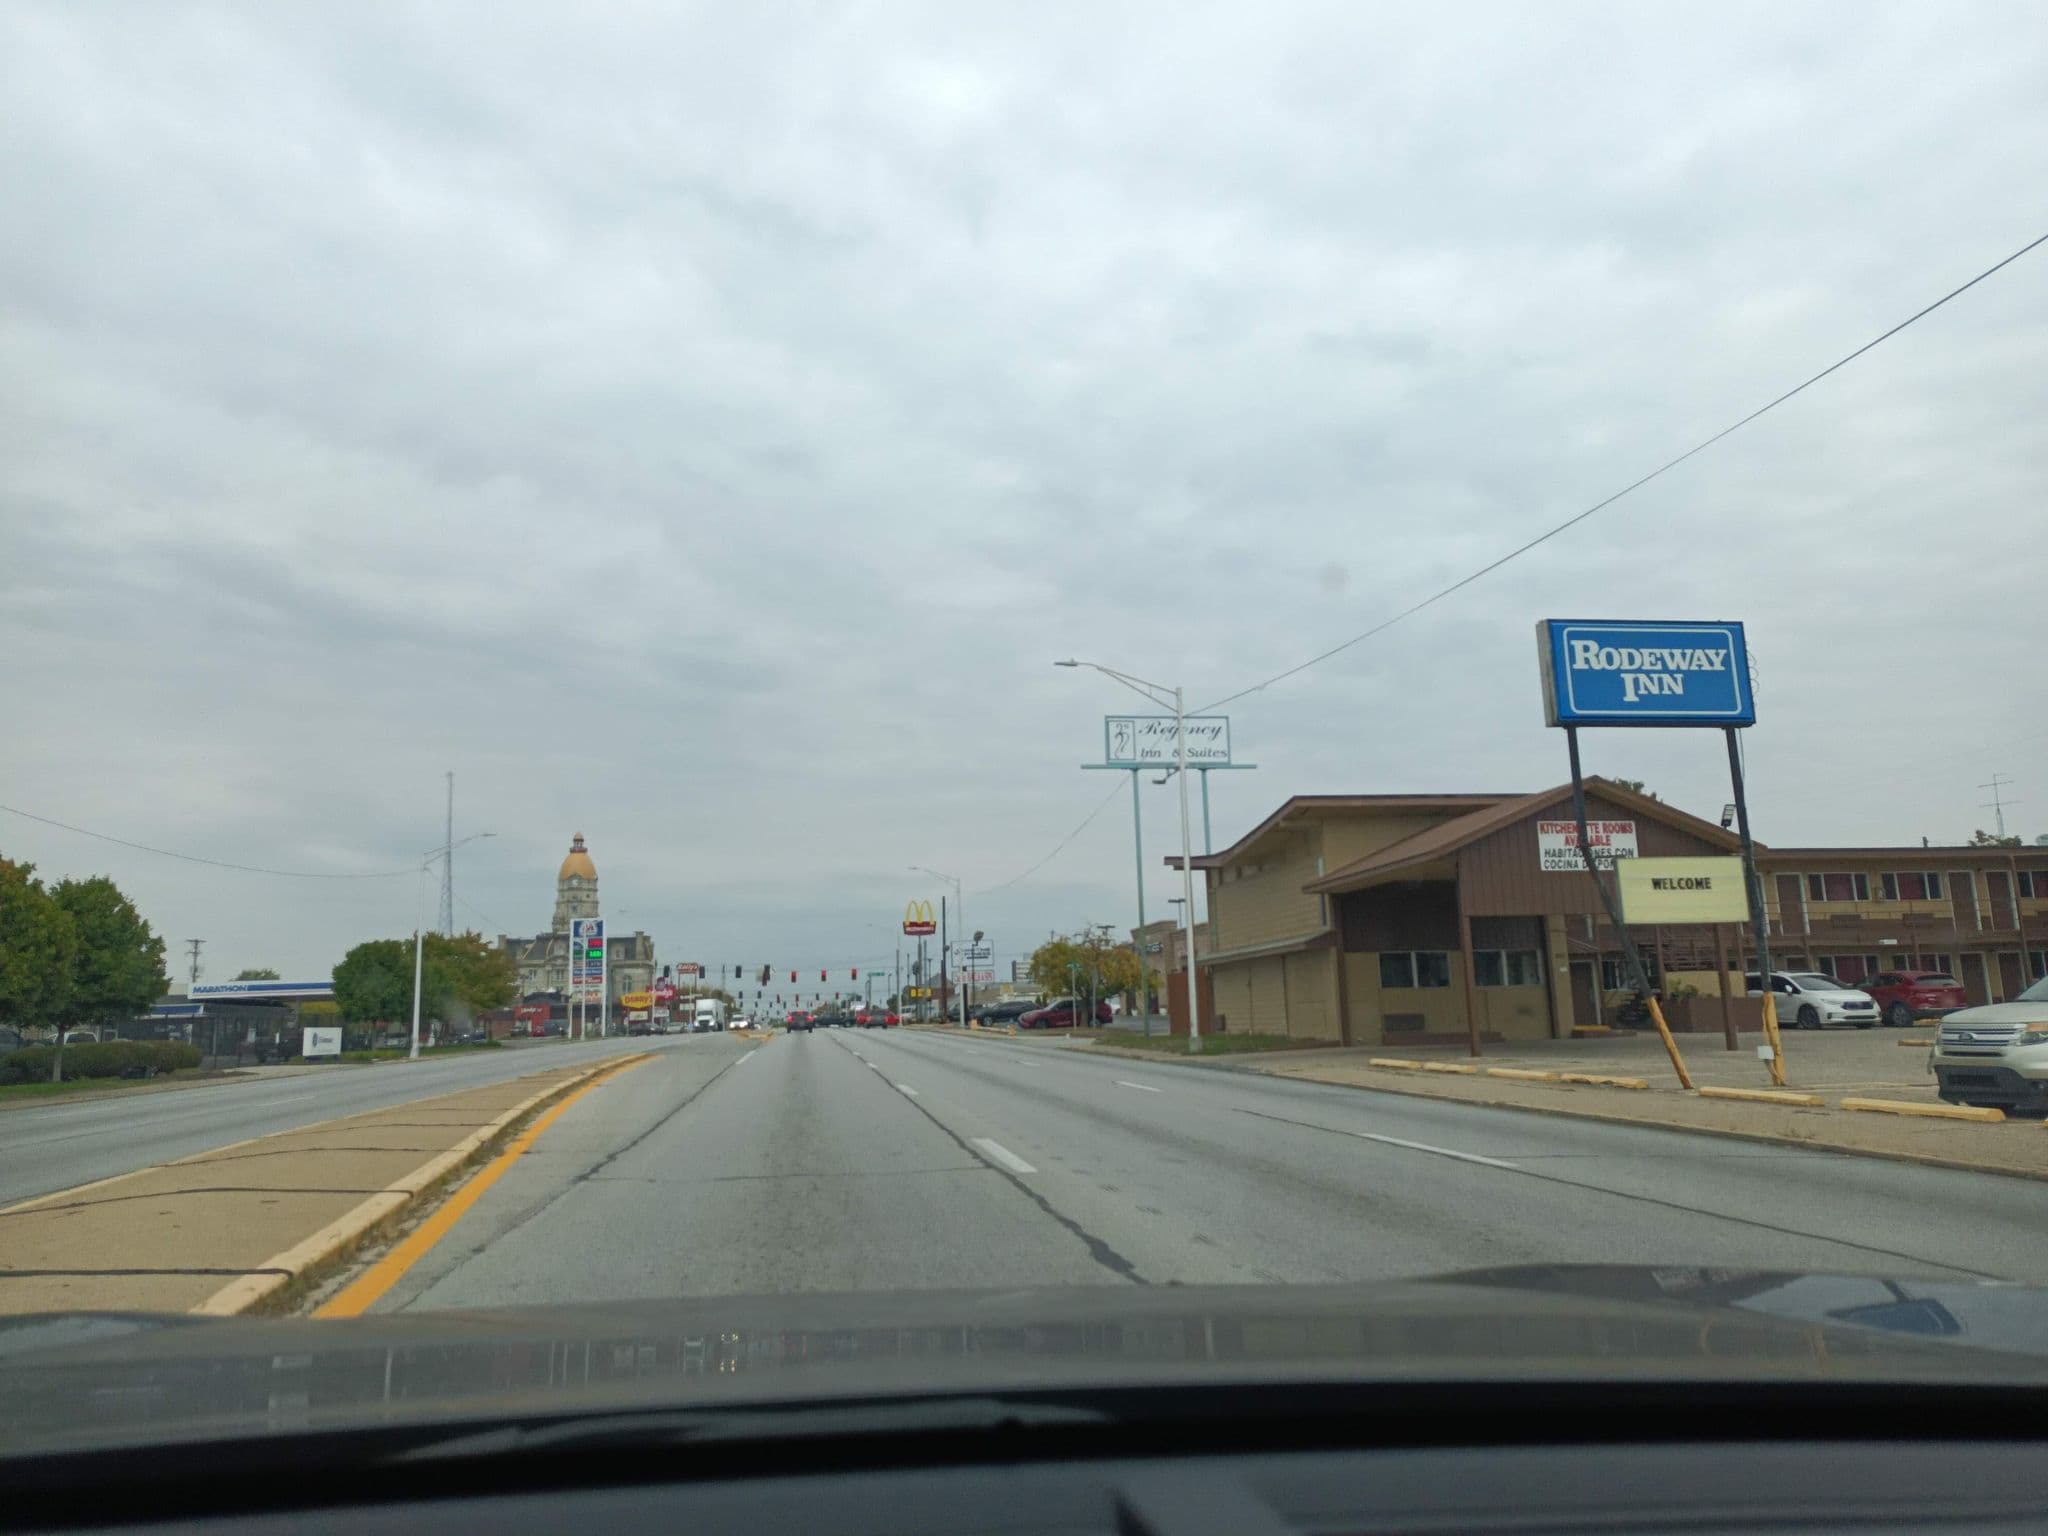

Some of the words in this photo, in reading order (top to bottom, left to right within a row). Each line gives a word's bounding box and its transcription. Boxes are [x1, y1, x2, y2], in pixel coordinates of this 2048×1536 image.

[1570, 639, 1727, 671] RODEWAY
[1620, 673, 1684, 702] INN
[1138, 720, 1222, 742] Regncy
[1141, 747, 1161, 757] Inn
[1187, 747, 1228, 758] Suites
[1539, 822, 1600, 834] KITCHENTE
[1602, 822, 1633, 834] ROOMS
[1544, 847, 1613, 858] HABITACONES
[1615, 847, 1634, 858] CON
[1544, 859, 1579, 869] COCINA
[1651, 877, 1712, 890] WELCOME
[192, 985, 247, 993] MARATHON
